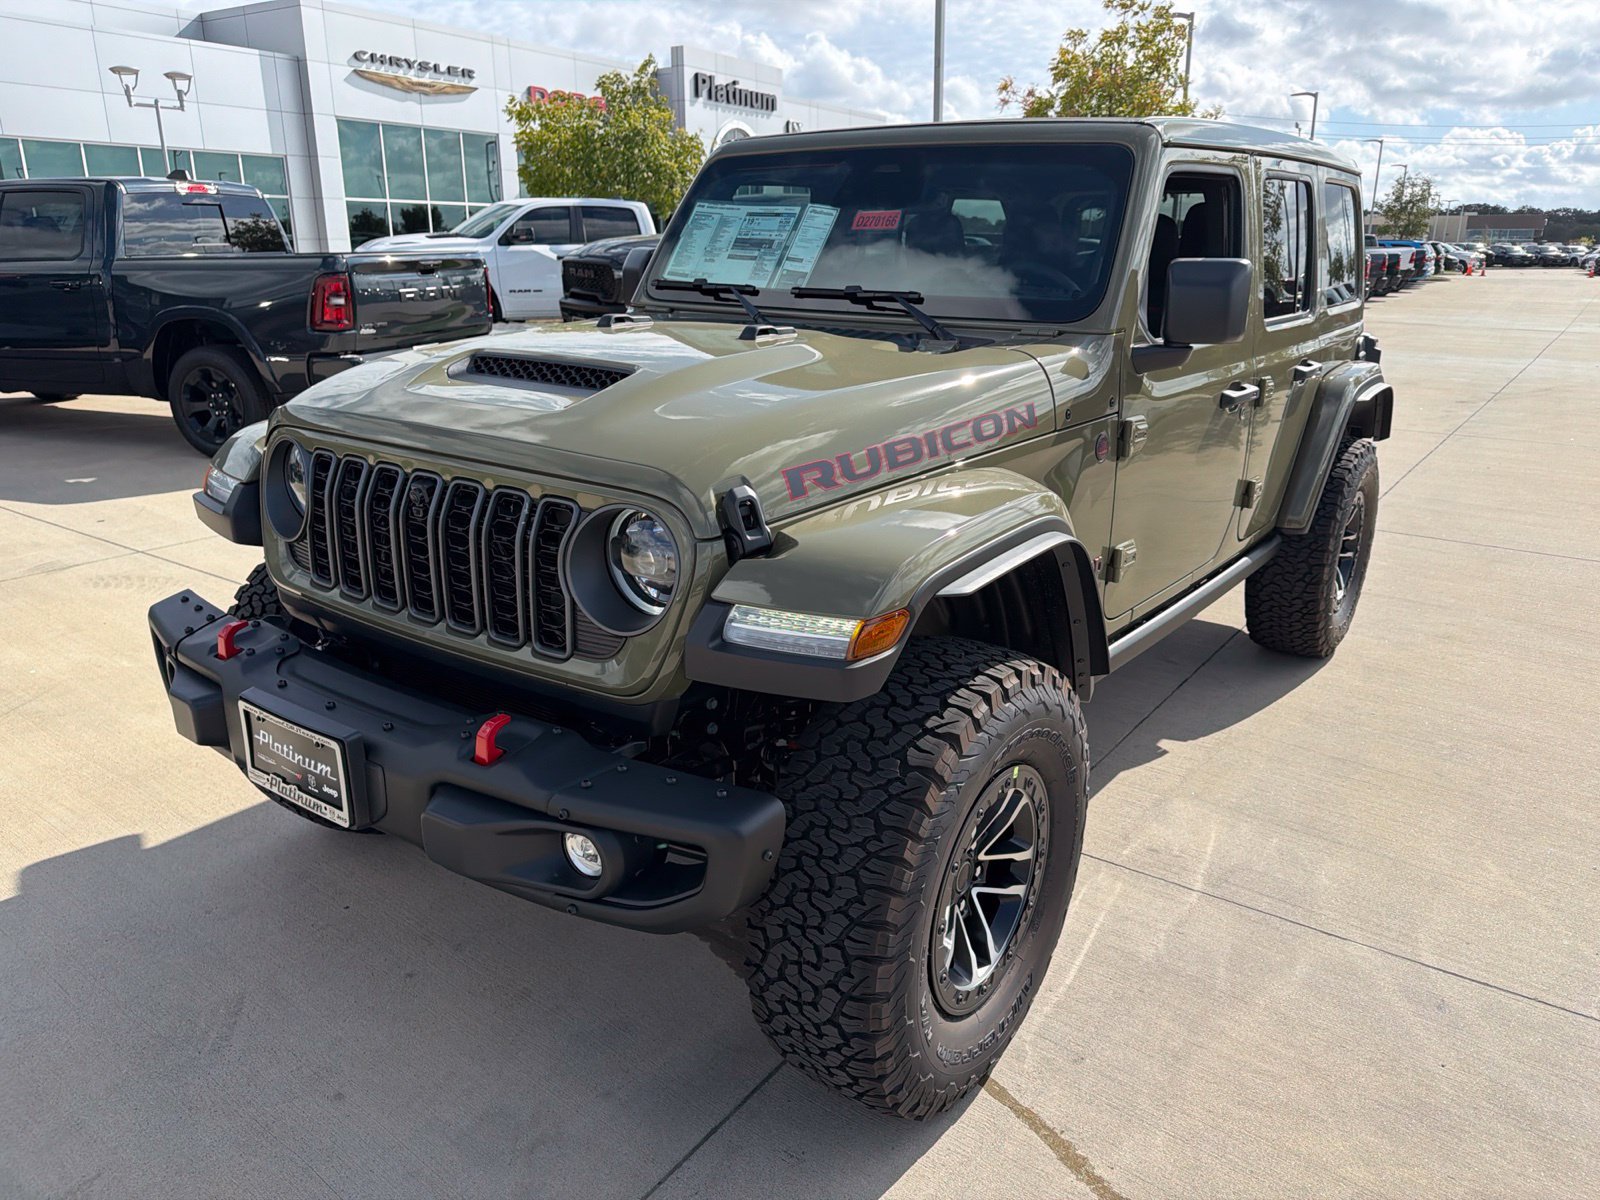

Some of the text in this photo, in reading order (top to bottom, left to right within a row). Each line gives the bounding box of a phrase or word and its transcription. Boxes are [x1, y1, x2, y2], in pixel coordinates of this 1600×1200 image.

[353, 50, 475, 79] CHRYSLER
[694, 72, 777, 112] Platinum
[569, 267, 595, 278] RAM
[398, 285, 462, 302] RAM
[781, 402, 1038, 501] RUBICON
[255, 729, 337, 781] Platinum
[269, 776, 328, 816] Platinum
[322, 784, 338, 798] Jeep
